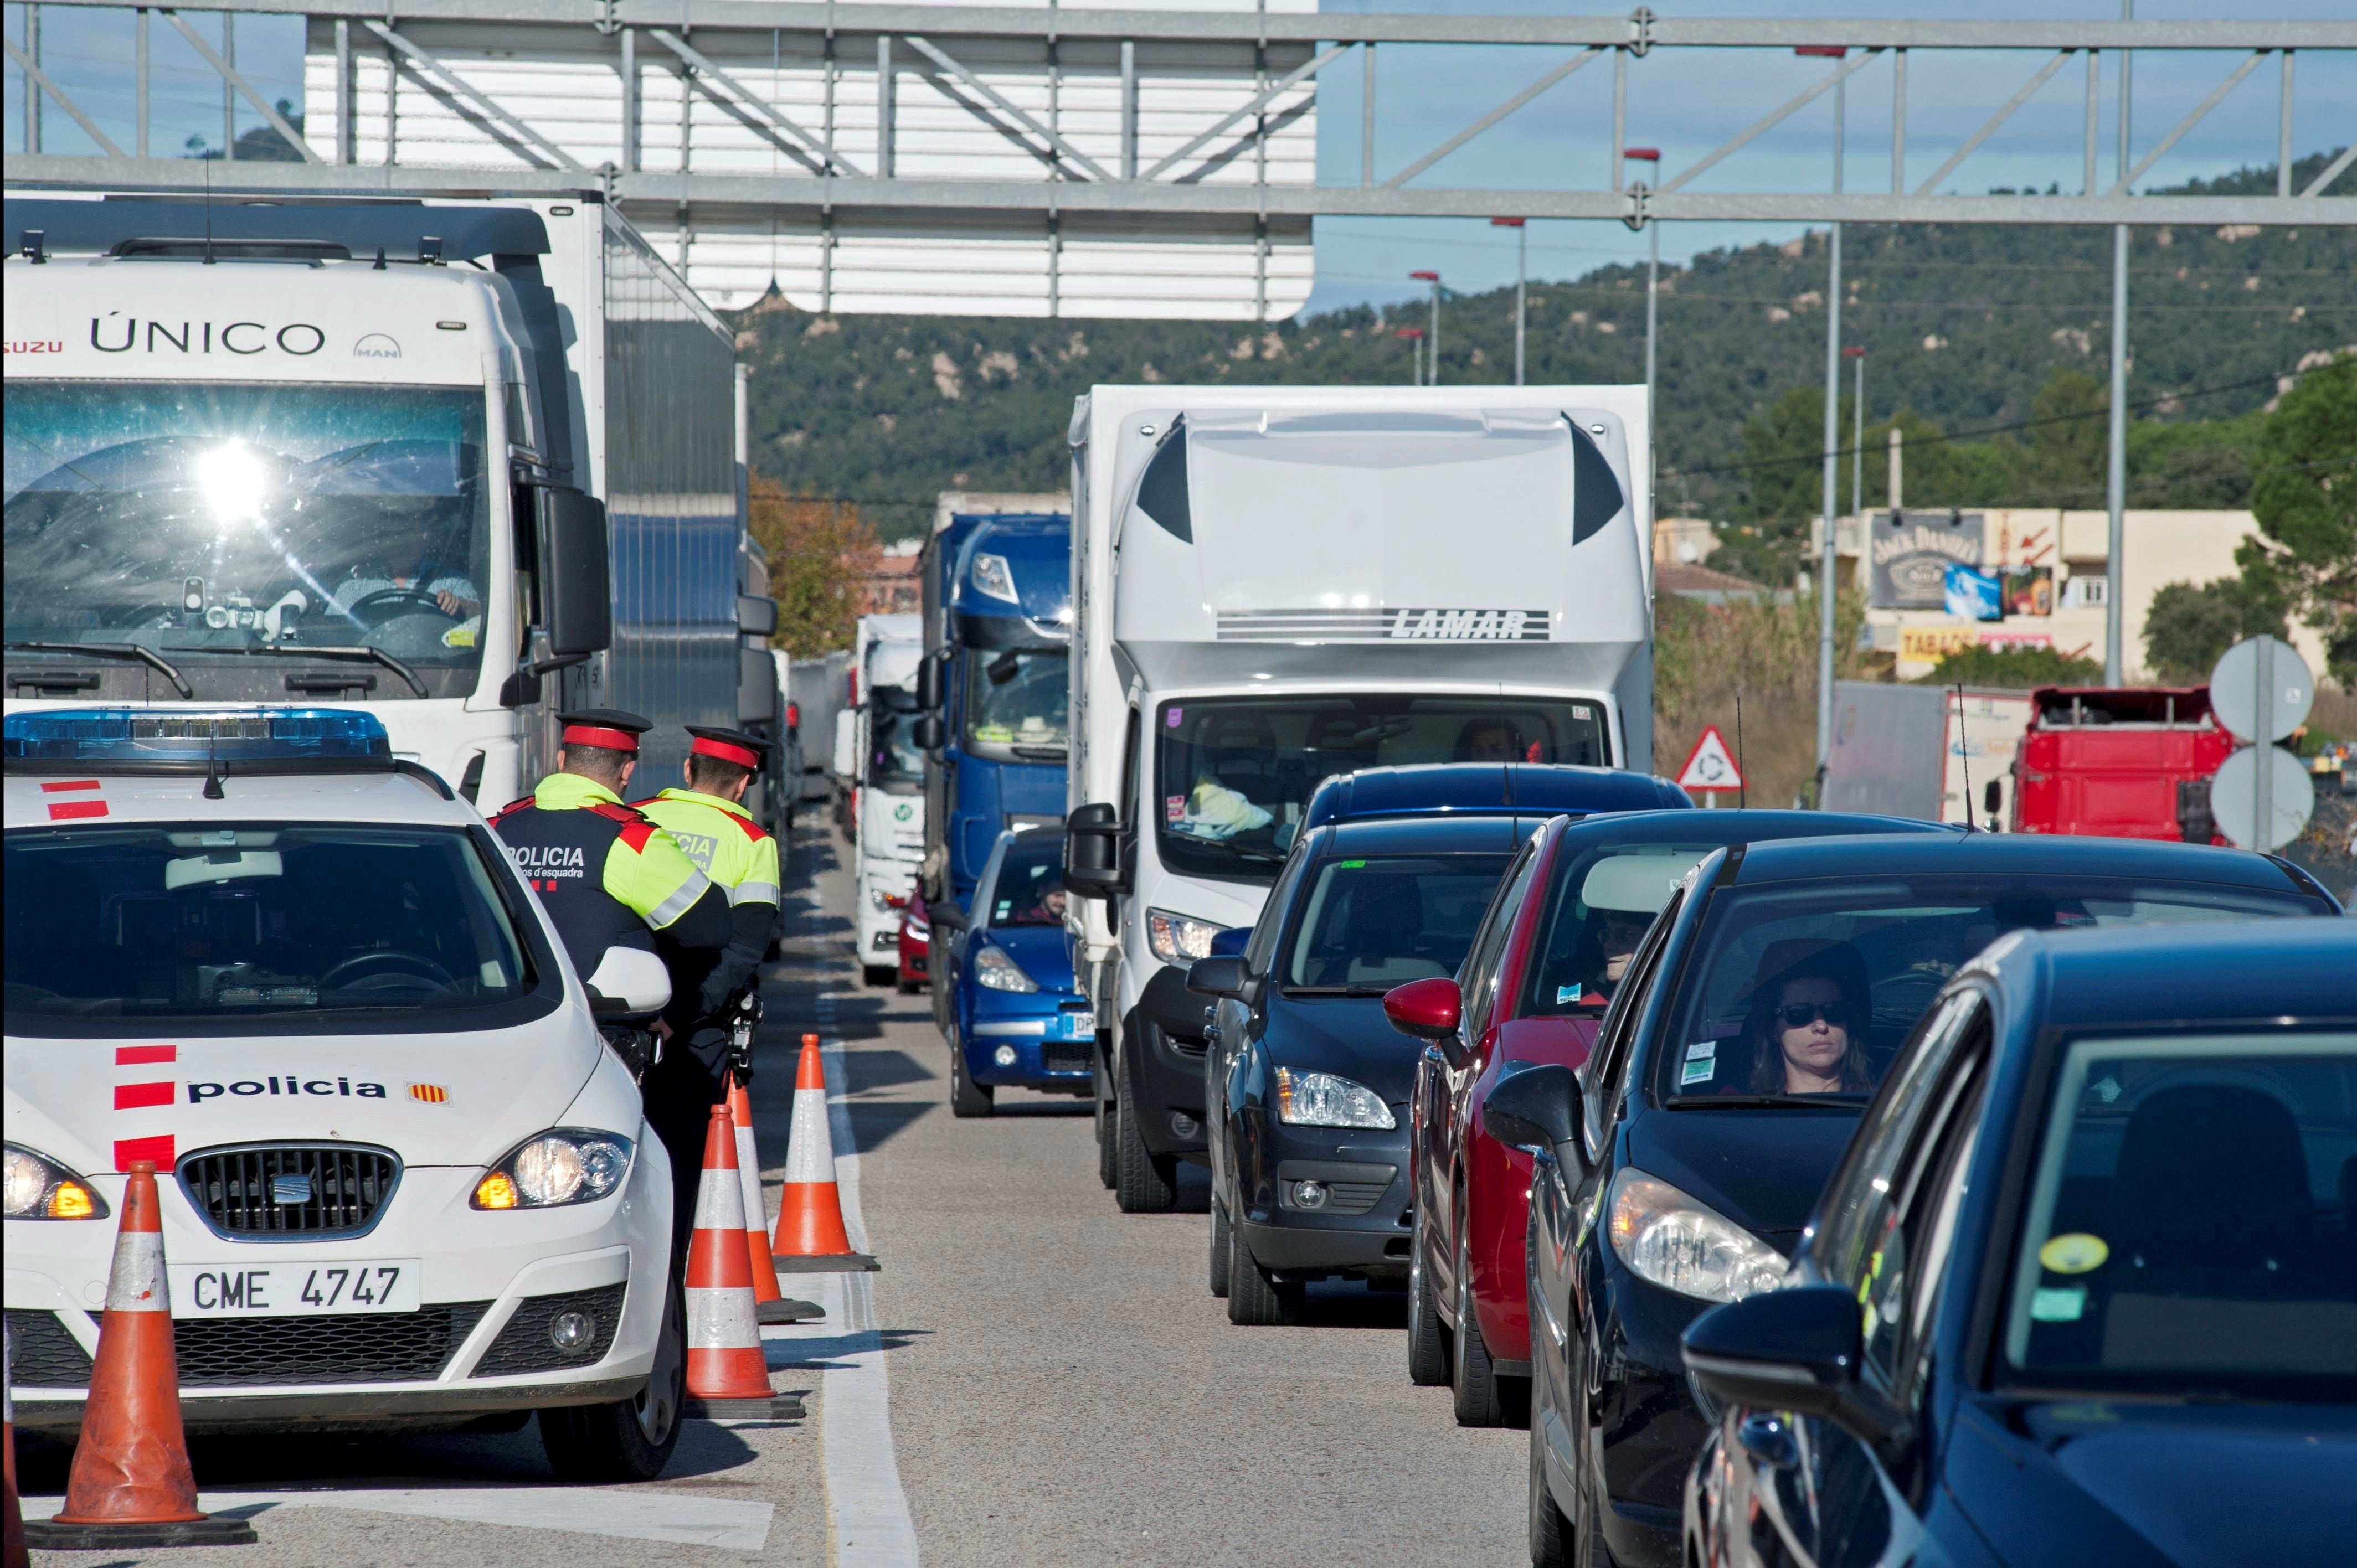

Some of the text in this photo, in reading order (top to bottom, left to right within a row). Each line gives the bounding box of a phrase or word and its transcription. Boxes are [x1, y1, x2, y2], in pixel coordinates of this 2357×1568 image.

[90, 311, 325, 355] ÚNICO
[357, 349, 398, 358] MAN
[1390, 608, 1528, 639] LAMAR
[672, 833, 710, 857] CIA
[188, 1076, 387, 1103] policia
[194, 1267, 399, 1309] CME 4747
